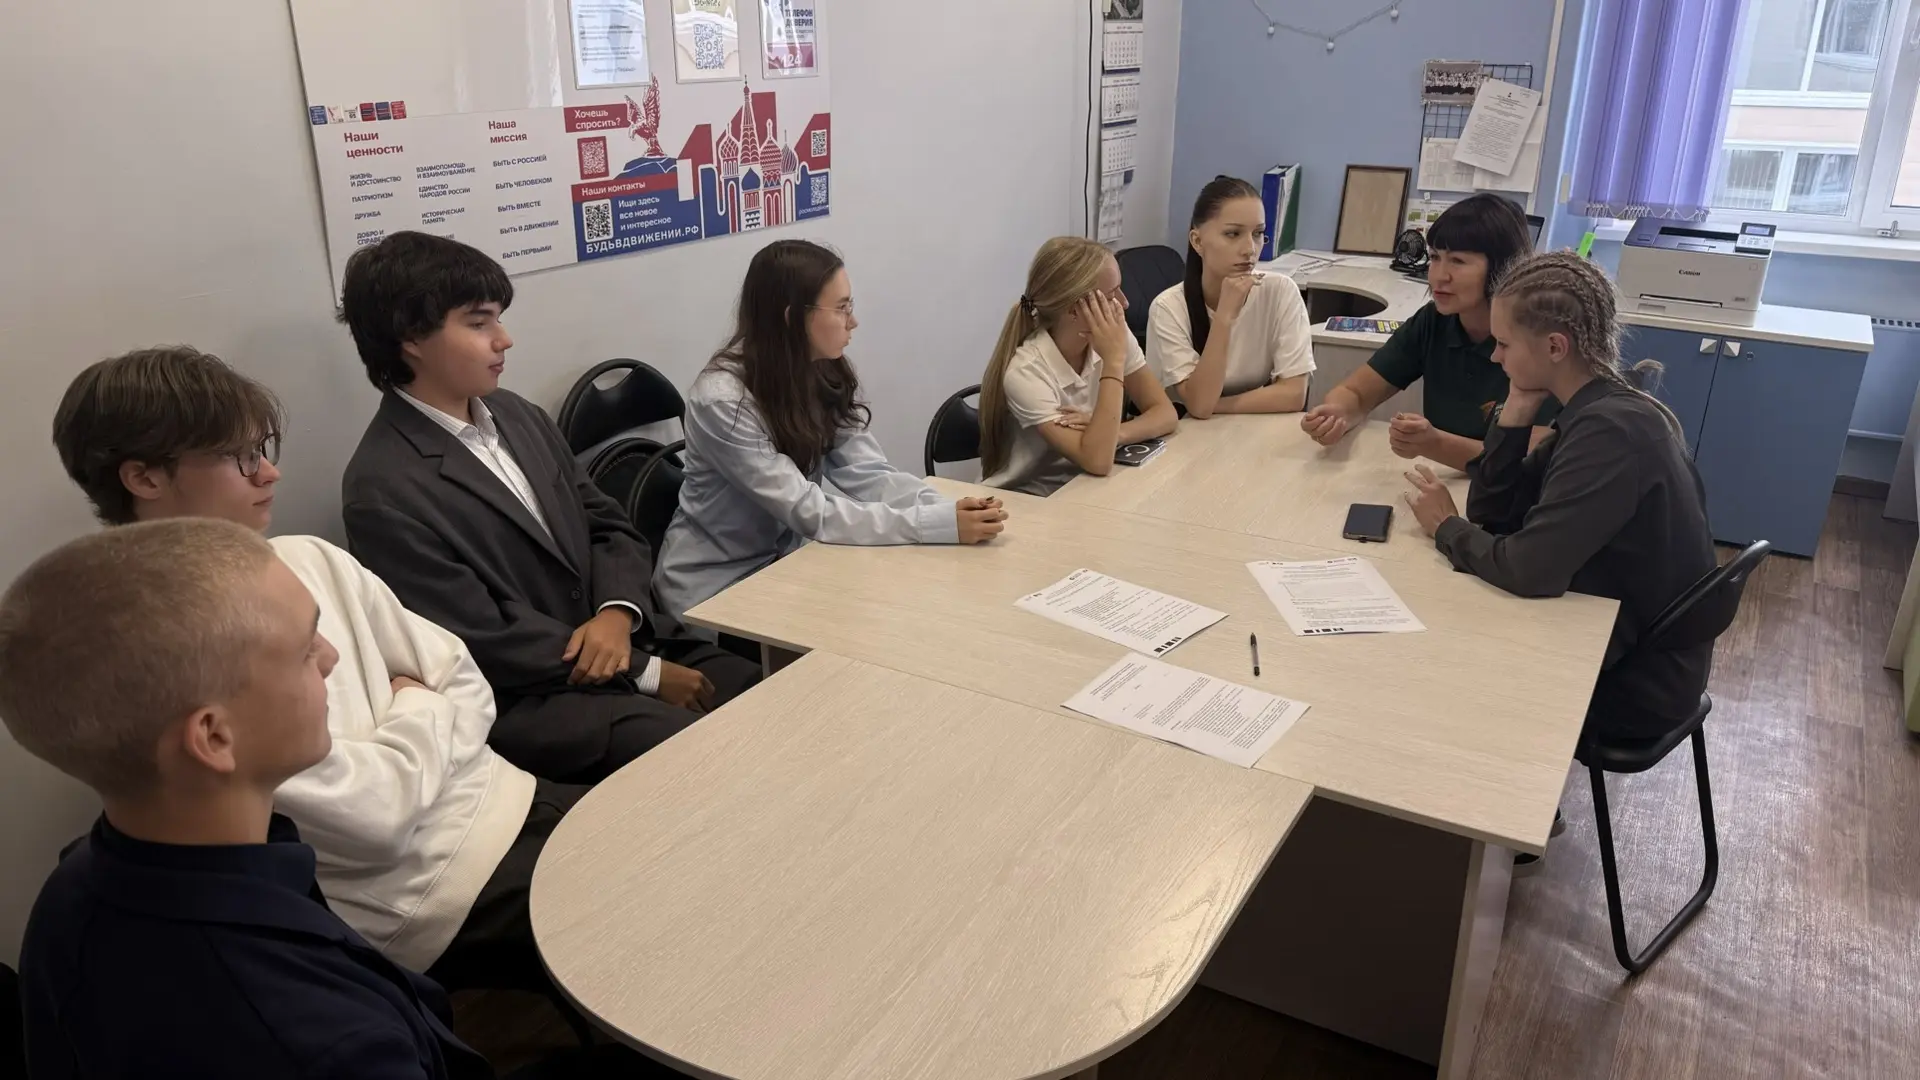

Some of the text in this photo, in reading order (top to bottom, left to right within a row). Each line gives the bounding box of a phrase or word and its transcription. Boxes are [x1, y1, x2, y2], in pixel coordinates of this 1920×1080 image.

[785, 18, 813, 27] ДВЕРИЯ
[575, 109, 608, 119] Хочешь
[488, 121, 516, 130] Наша
[576, 118, 620, 130] спросить?
[344, 132, 379, 142] Наши
[490, 133, 527, 144] миссия
[346, 145, 403, 159] ценности
[493, 160, 511, 168] БЫТЬ
[516, 154, 547, 164] РОССИЕЙ
[416, 162, 466, 173] ВЗАИМОПОМОЩЬ
[422, 167, 476, 179] ВЗАИМОУВАЖЕНИЕ
[356, 176, 401, 187] ДОСТОИНСТВО
[495, 177, 552, 190] БЫТЬ ЧЕЛОВЕКОМ
[418, 184, 449, 193] ЕДИНСТВО
[419, 187, 471, 199] НАРОДОВ РОССИИ
[582, 181, 646, 197] Наши контакты
[352, 192, 393, 203] ПАТРИОТИЗМ
[618, 196, 660, 208] Ищи здесь
[498, 200, 541, 213] БЫТЬ ВМЕСТЕ
[354, 211, 381, 220] ДРУЖБА
[421, 207, 465, 219] ИСТОРИЧЕСКАЯ
[619, 207, 658, 219] все новое
[422, 216, 445, 225] ПАМЯТЬ
[620, 217, 672, 231] и интересное
[500, 227, 518, 235] БЫТЬ
[523, 220, 559, 232] ДВИЖЕНИИ
[356, 230, 379, 240] ДОБРО
[586, 224, 700, 254] БУДЬВДВИЖЕНИИ.РФ
[502, 244, 552, 259] БЫТЬ ПЕРВЫМИ
